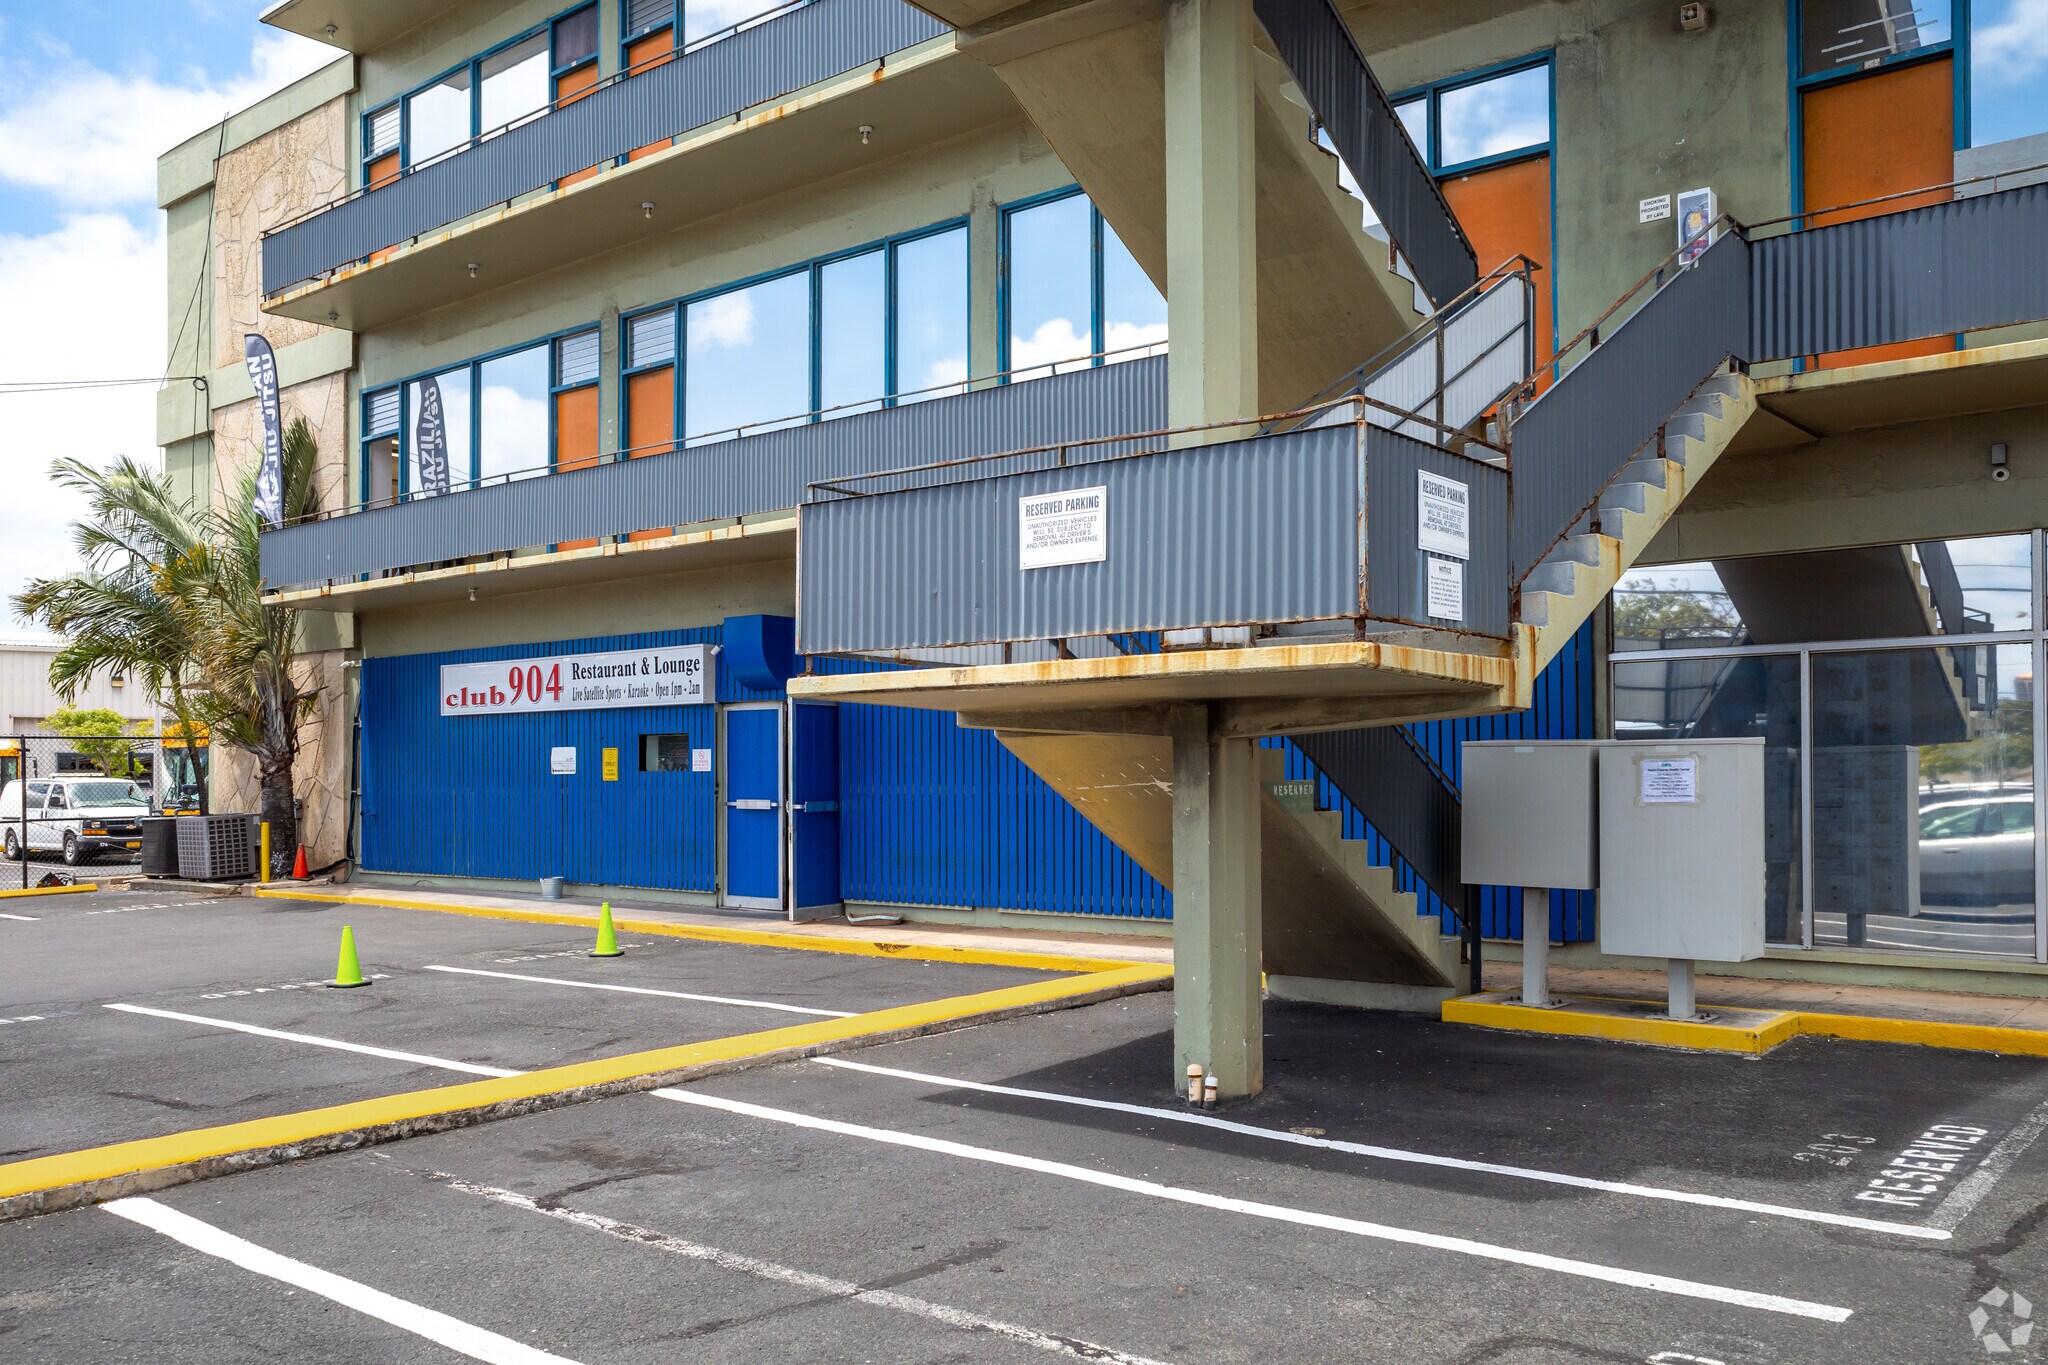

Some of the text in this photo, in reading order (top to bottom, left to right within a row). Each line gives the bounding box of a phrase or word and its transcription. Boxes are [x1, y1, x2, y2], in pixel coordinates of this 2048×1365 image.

[1641, 204, 1669, 214] PROHIBITED
[1643, 198, 1666, 206] SMOKING
[261, 353, 276, 421] JITSU
[267, 429, 278, 468] JIU
[1423, 479, 1465, 505] RESERVED PARKING
[1025, 495, 1099, 517] RESERVED PARKING
[1028, 515, 1097, 530] UNAUTHORIZED VEHICLES
[1057, 524, 1081, 532] SUBJECT
[1026, 541, 1048, 549] AND/OR
[1050, 538, 1073, 546] OWNER'S
[1033, 534, 1057, 542] REMOVAL
[1067, 529, 1091, 538] DRIVER'S
[1438, 565, 1452, 575] NOTICE
[572, 656, 700, 680] Restaurant & Lounge
[445, 663, 564, 708] club 904
[572, 687, 582, 701] Live
[583, 685, 604, 700] Satellite
[605, 685, 621, 702] Sports
[628, 682, 648, 698] Karaoke
[655, 681, 669, 699] Open
[671, 681, 682, 698] 1pm
[689, 680, 700, 695] 2am
[1273, 784, 1314, 796] RESERVED
[1854, 1124, 1988, 1207] RESERVED
